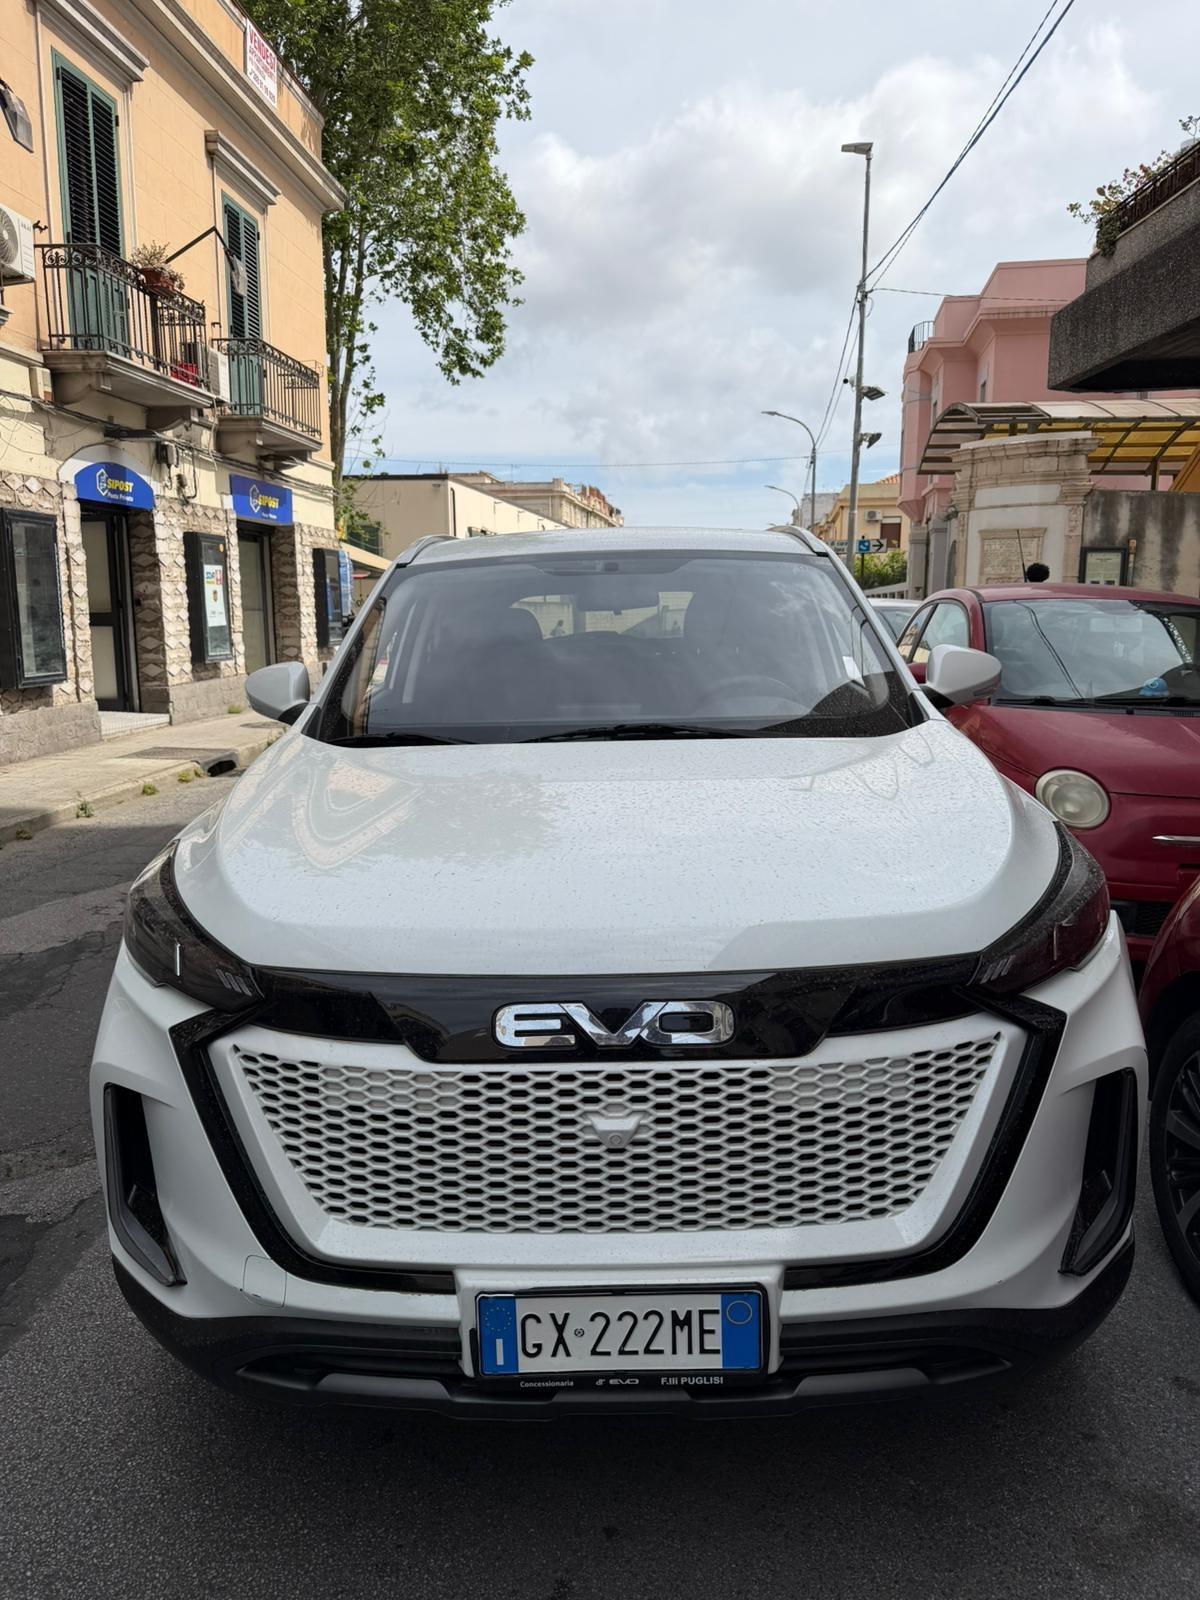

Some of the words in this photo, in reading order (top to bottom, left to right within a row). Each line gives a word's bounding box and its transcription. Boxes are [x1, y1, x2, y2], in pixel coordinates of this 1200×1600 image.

[249, 26, 276, 73] VENDESI
[107, 478, 134, 493] SIPOST
[256, 494, 279, 509] SIPOST
[493, 1000, 735, 1048] EVO
[520, 1312, 572, 1359] GX
[589, 1308, 721, 1357] 222ME
[519, 1380, 575, 1388] Concessionaria
[680, 1376, 724, 1385] PUGLISI
